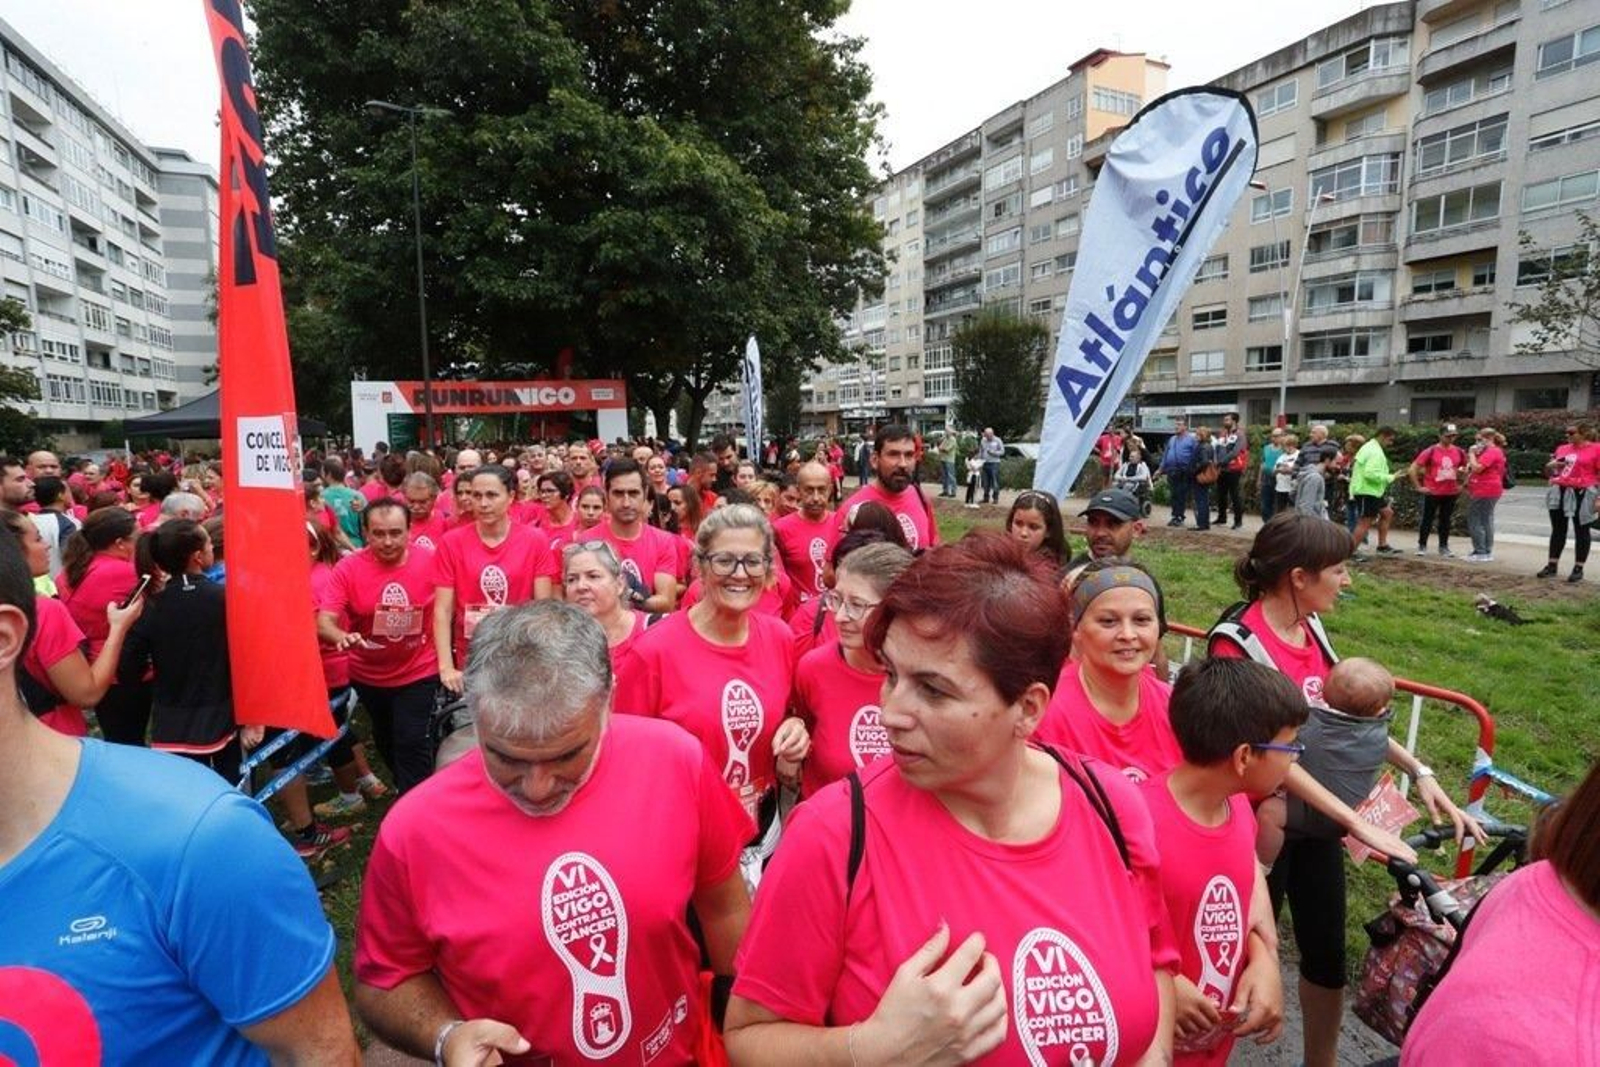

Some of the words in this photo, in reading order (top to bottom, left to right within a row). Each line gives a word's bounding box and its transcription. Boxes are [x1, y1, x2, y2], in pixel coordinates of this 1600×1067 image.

[1055, 127, 1231, 422] Atlántico
[557, 864, 587, 889] VI
[553, 891, 609, 921] VIGO
[1212, 886, 1227, 902] VI
[555, 911, 599, 933] CONTRA
[600, 907, 616, 918] EL
[1203, 910, 1237, 924] VIGO
[59, 927, 118, 946] Kalenji
[1030, 946, 1068, 974] VI
[1027, 988, 1095, 1015] VIGO
[1028, 1013, 1084, 1030] CONTRA
[1086, 1011, 1105, 1024] EL
